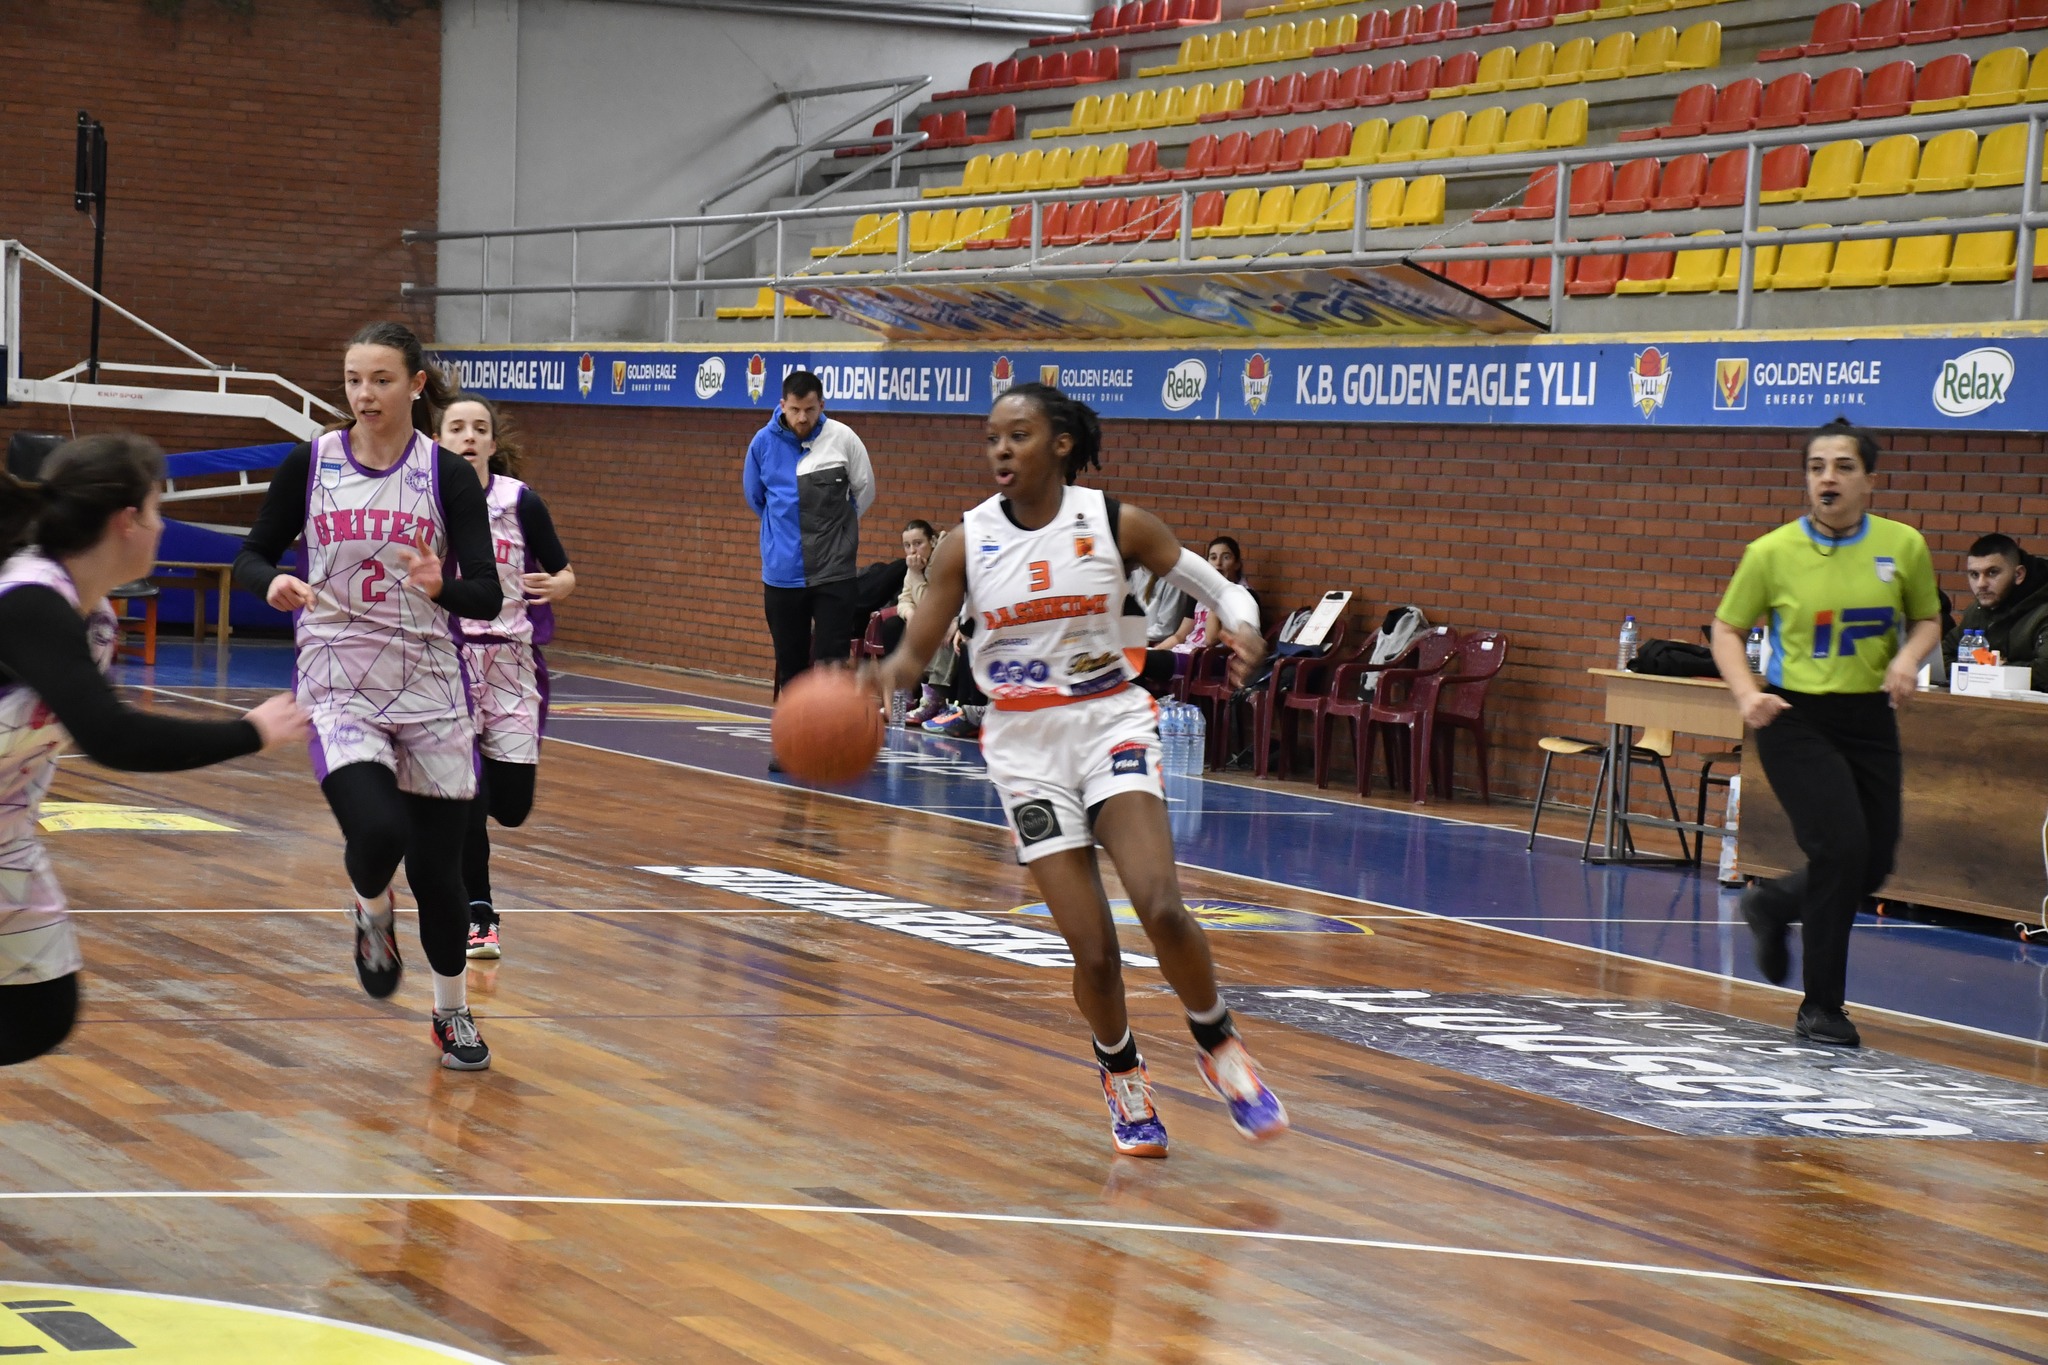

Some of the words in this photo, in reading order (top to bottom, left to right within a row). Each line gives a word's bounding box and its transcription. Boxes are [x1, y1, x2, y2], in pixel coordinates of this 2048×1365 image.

[500, 361, 537, 389] EAGLE
[540, 361, 565, 390] YLLI
[627, 364, 655, 379] GOLDEN
[656, 364, 676, 379] EAGLE
[699, 365, 722, 391] Relax
[878, 367, 931, 401] EAGLE
[934, 367, 971, 402] YLLI
[1061, 369, 1100, 387] GOLDEN
[1102, 369, 1133, 387] EAGLE
[1167, 369, 1203, 401] Relax
[1296, 364, 1337, 405] K.B.
[1342, 363, 1441, 405] GOLDEN
[1445, 362, 1531, 405] EAGLE
[1537, 361, 1597, 405] YLLI
[1754, 362, 1822, 386] GOLDEN
[1826, 360, 1881, 385] EAGLE
[1943, 361, 2004, 404] Relax
[1101, 393, 1124, 401] DRINK
[1640, 379, 1658, 395] YLLI
[1766, 394, 1814, 405] ENERGY
[1824, 393, 1864, 405] DRINK
[313, 508, 436, 548] UNITED
[361, 559, 387, 603] 2
[1028, 560, 1052, 592] 3
